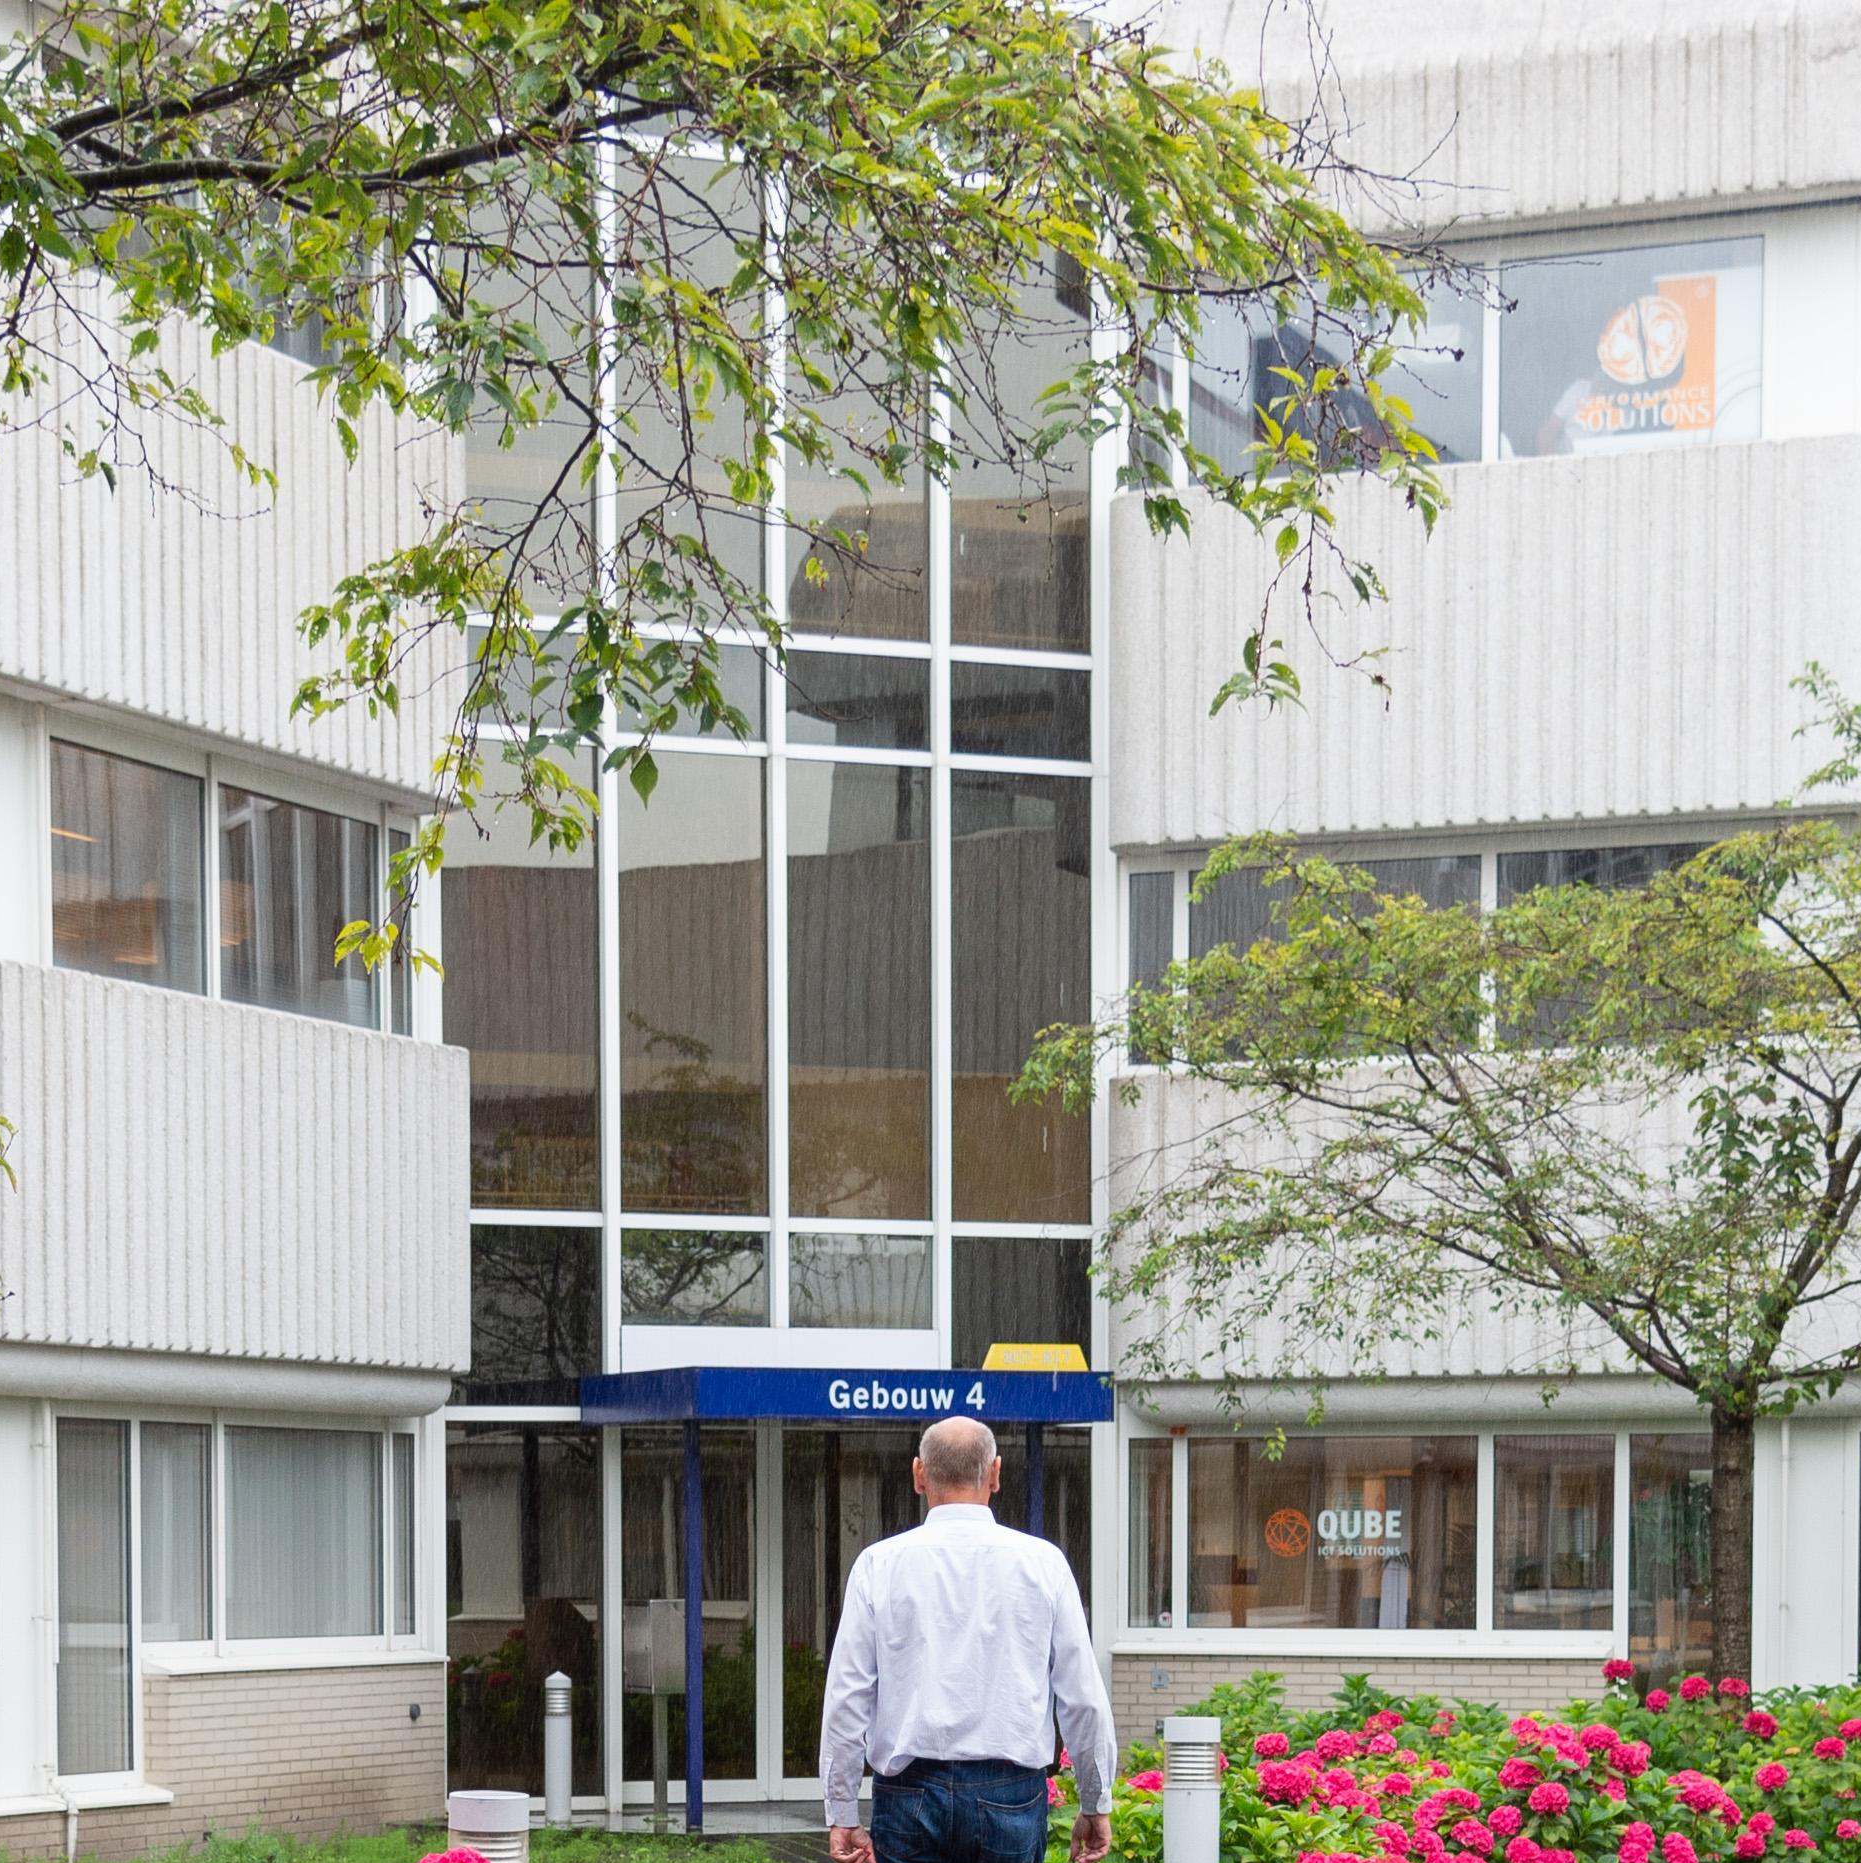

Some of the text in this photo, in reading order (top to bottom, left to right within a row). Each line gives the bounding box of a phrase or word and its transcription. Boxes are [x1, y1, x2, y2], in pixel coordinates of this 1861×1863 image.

[828, 1379, 986, 1411] Gebouw 4
[1317, 1509, 1402, 1541] QUBE
[1317, 1545, 1401, 1557] ICT SOLUTIONS
